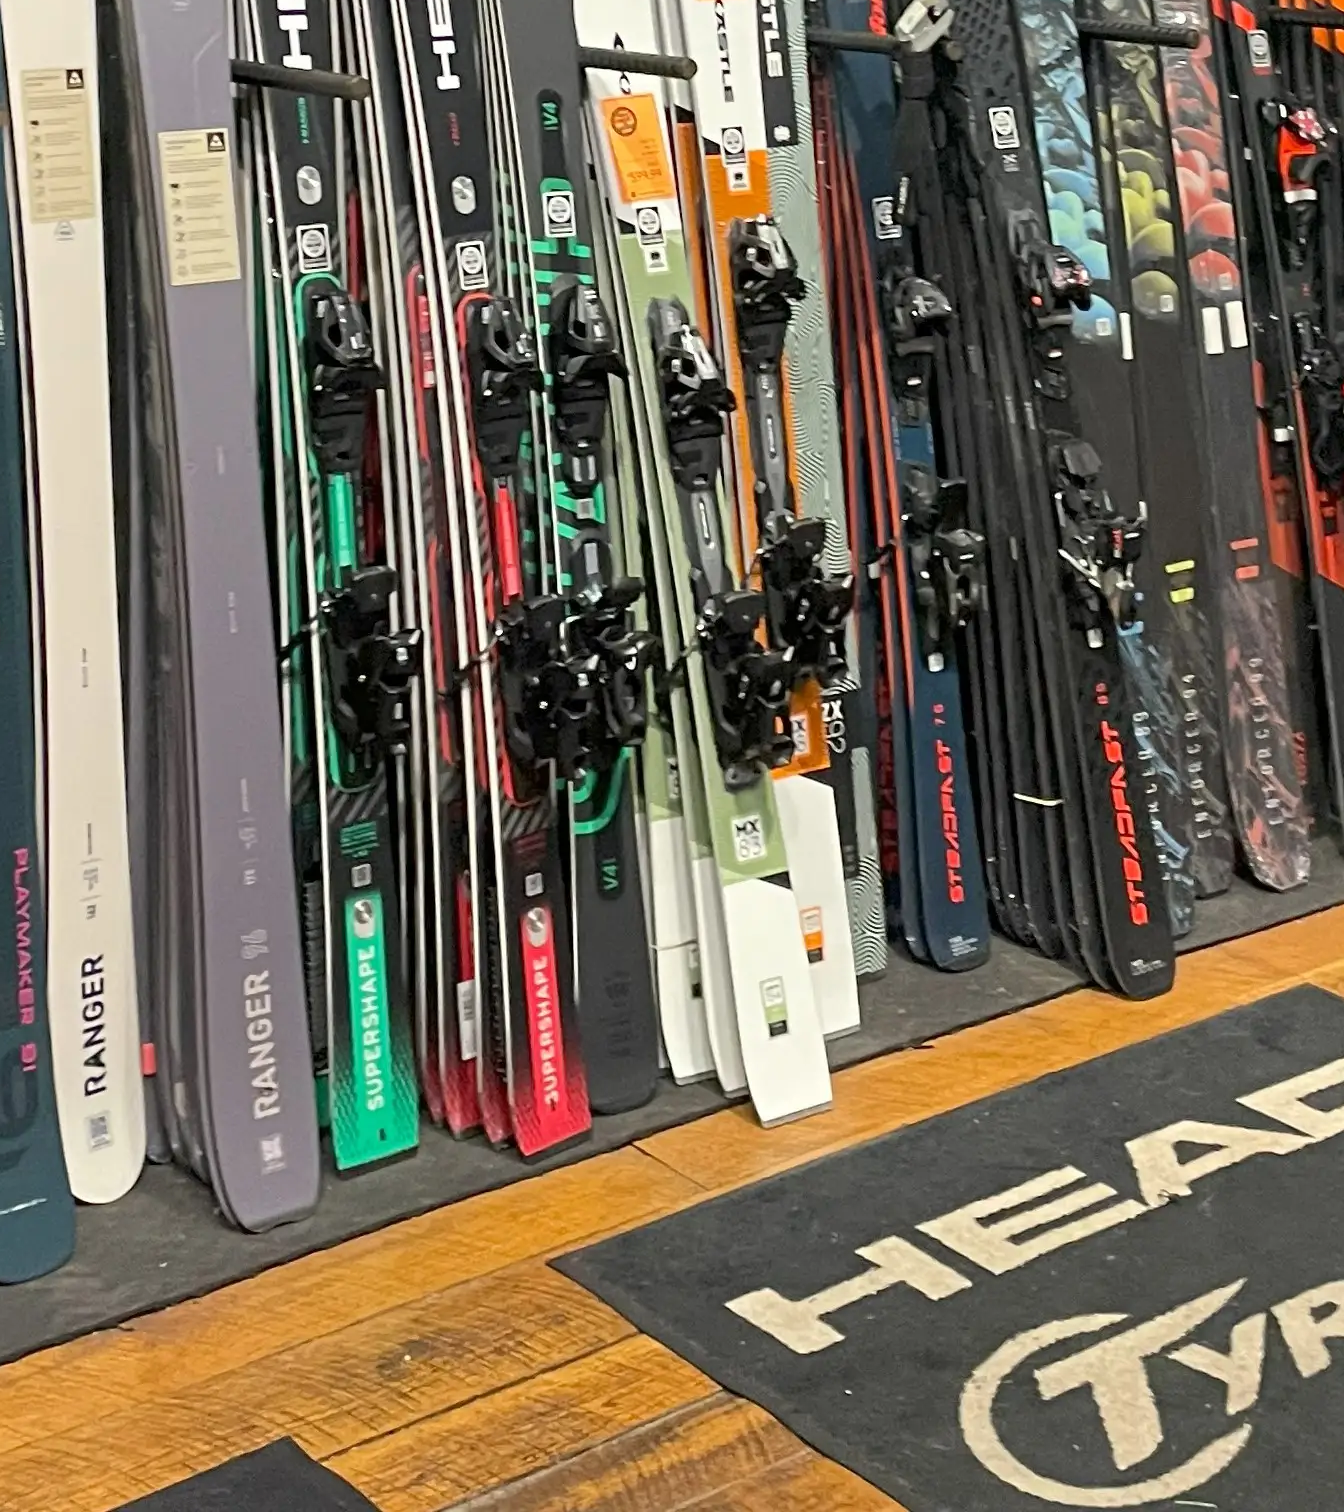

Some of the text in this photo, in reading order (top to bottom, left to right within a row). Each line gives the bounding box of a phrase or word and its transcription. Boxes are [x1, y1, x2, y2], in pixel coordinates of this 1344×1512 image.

[934, 737, 966, 905] STEADFAST
[1098, 719, 1151, 927] STEADFAST
[11, 847, 37, 1026] PLAYMAKER
[79, 951, 107, 1099] RANGER
[242, 969, 283, 1121] RANGER
[356, 944, 387, 1111] SUPERSHAPE
[533, 954, 562, 1106] SUPERSHAPE
